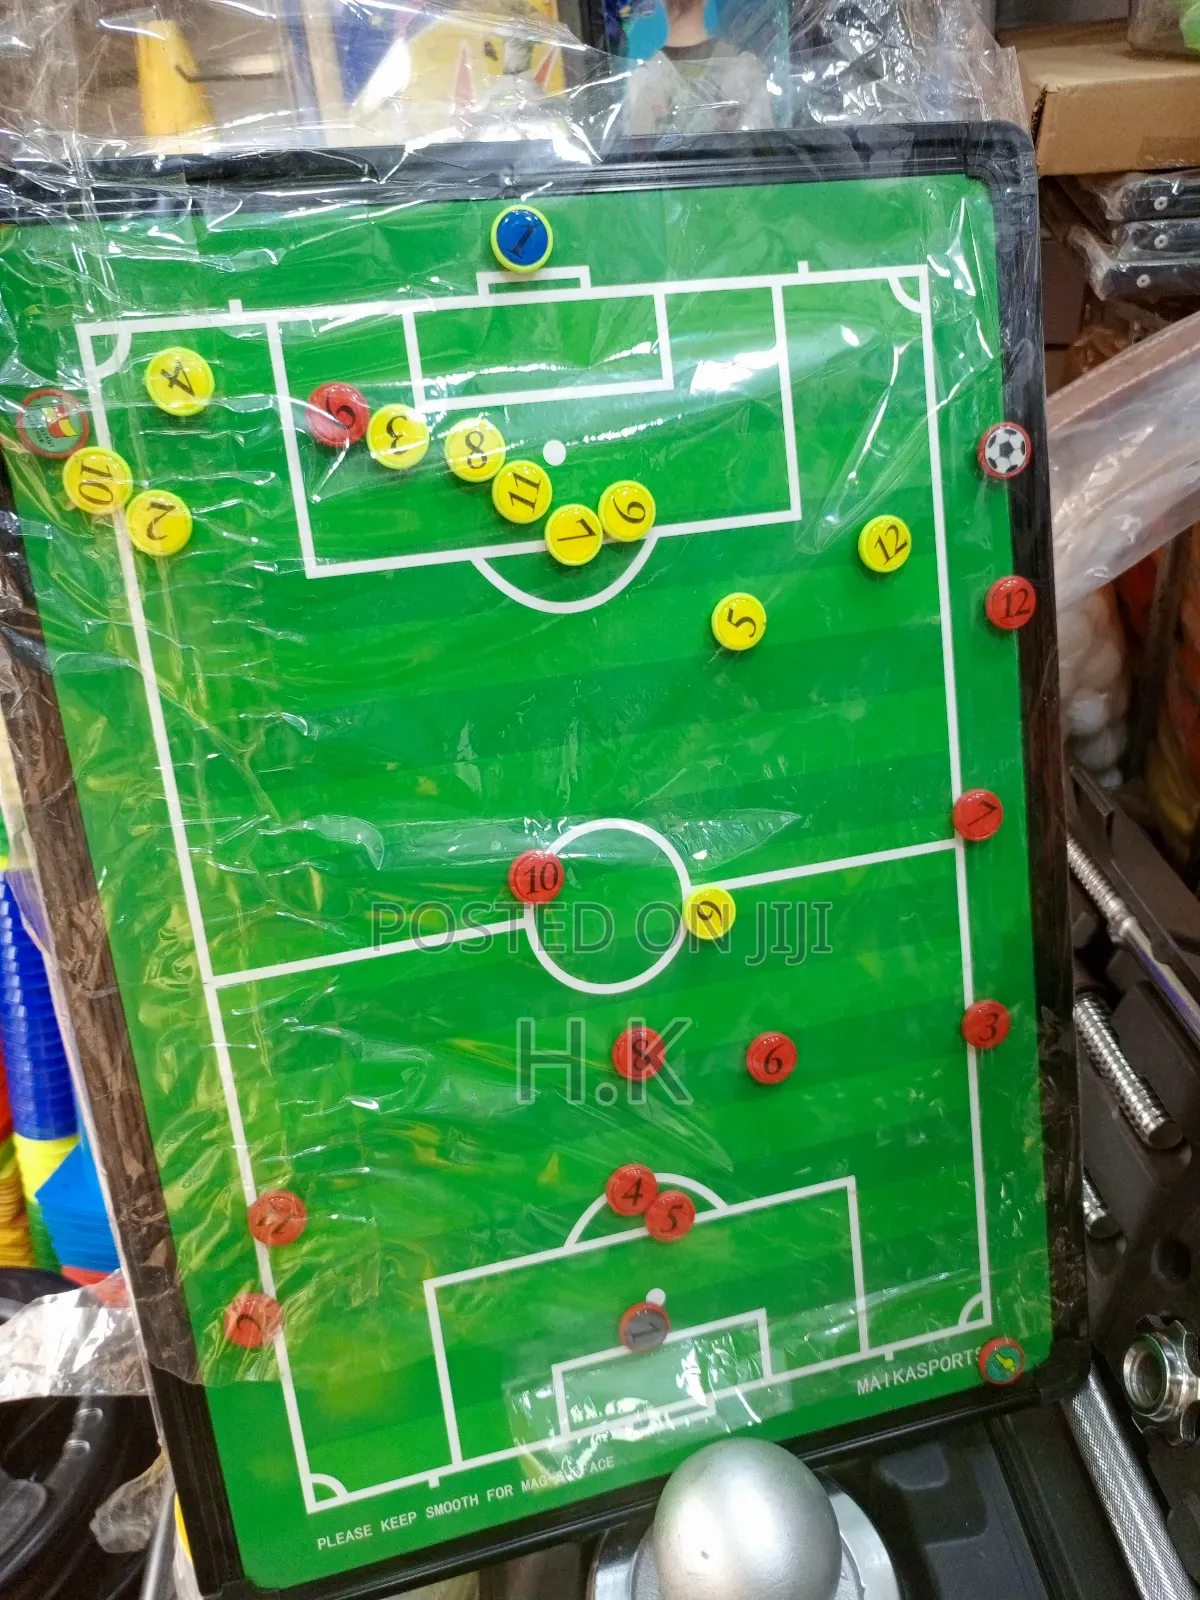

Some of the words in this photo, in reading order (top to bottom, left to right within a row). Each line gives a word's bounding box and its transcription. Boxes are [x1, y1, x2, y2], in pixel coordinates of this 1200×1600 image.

[506, 222, 536, 260] 1
[159, 360, 196, 397] 4
[386, 415, 408, 455] 3
[465, 430, 487, 469] 8
[78, 459, 115, 505] 10
[508, 472, 542, 514] 11
[145, 500, 176, 542] 2
[556, 518, 597, 542] 7
[873, 524, 908, 566] 12
[1001, 588, 1031, 619] 12
[726, 608, 757, 638] 5
[966, 800, 998, 827] 7
[523, 861, 559, 896] 10
[977, 1012, 999, 1042] 3
[631, 1038, 654, 1072] 8
[763, 1042, 784, 1076] 6
[621, 1176, 643, 1206] 4
[660, 1203, 684, 1233] 5
[629, 1321, 661, 1345] 1
[316, 1523, 373, 1551] PLEASE
[380, 1511, 418, 1533] KEEP
[425, 1493, 479, 1519] SMOOTH
[486, 1483, 514, 1502] FOR
